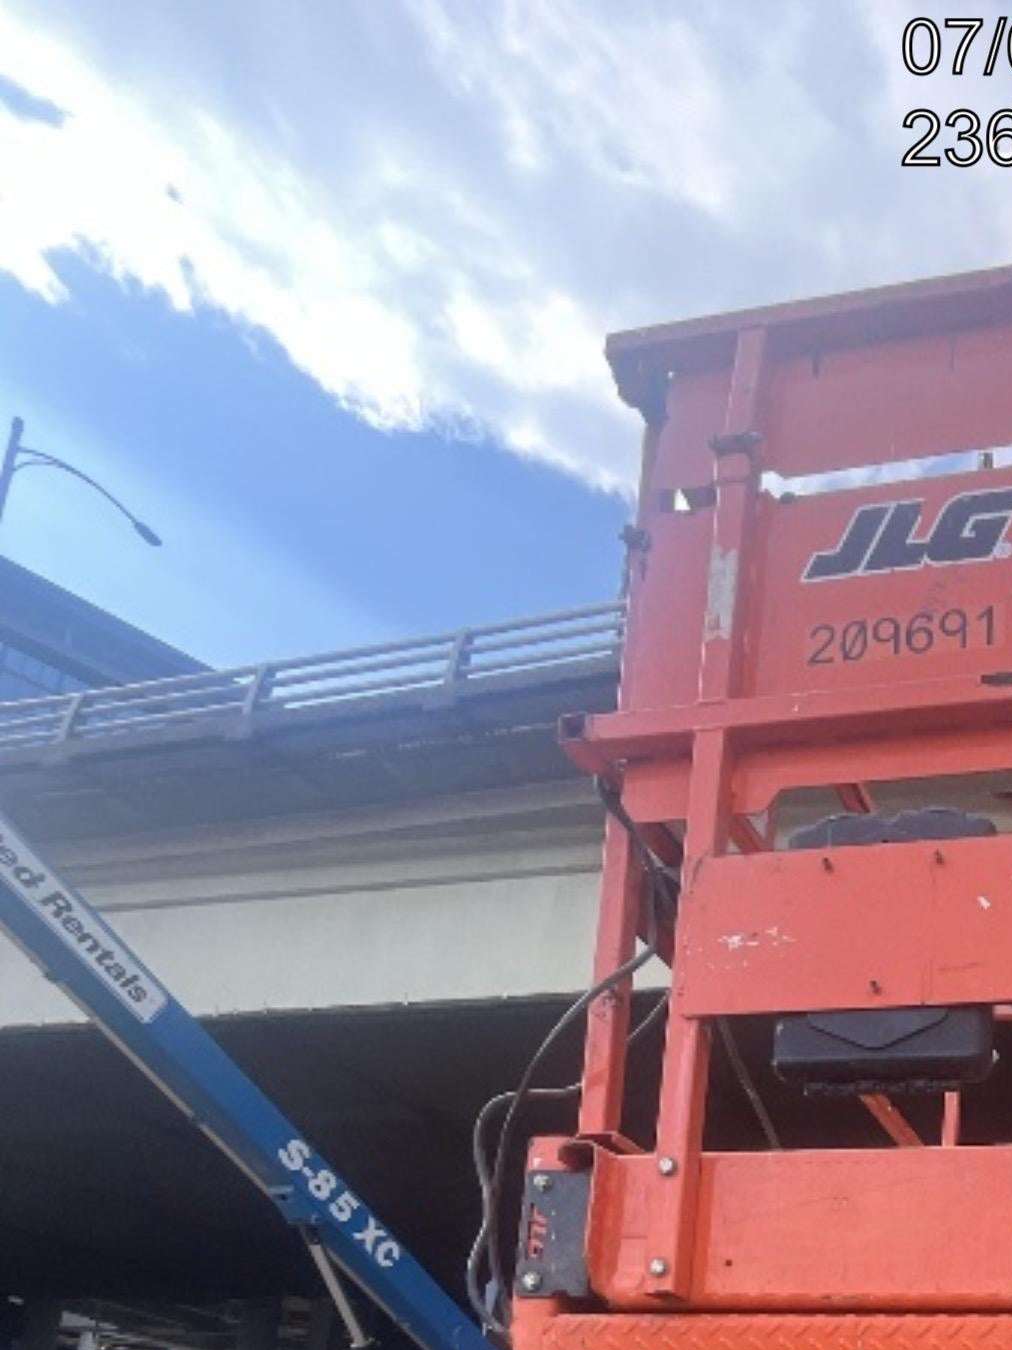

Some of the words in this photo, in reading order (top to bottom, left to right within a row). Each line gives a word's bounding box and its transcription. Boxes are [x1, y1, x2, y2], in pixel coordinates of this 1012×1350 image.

[807, 605, 996, 666] 209691
[0, 834, 46, 888] ed
[39, 890, 148, 1003] Rentals
[353, 1214, 400, 1267] XC
